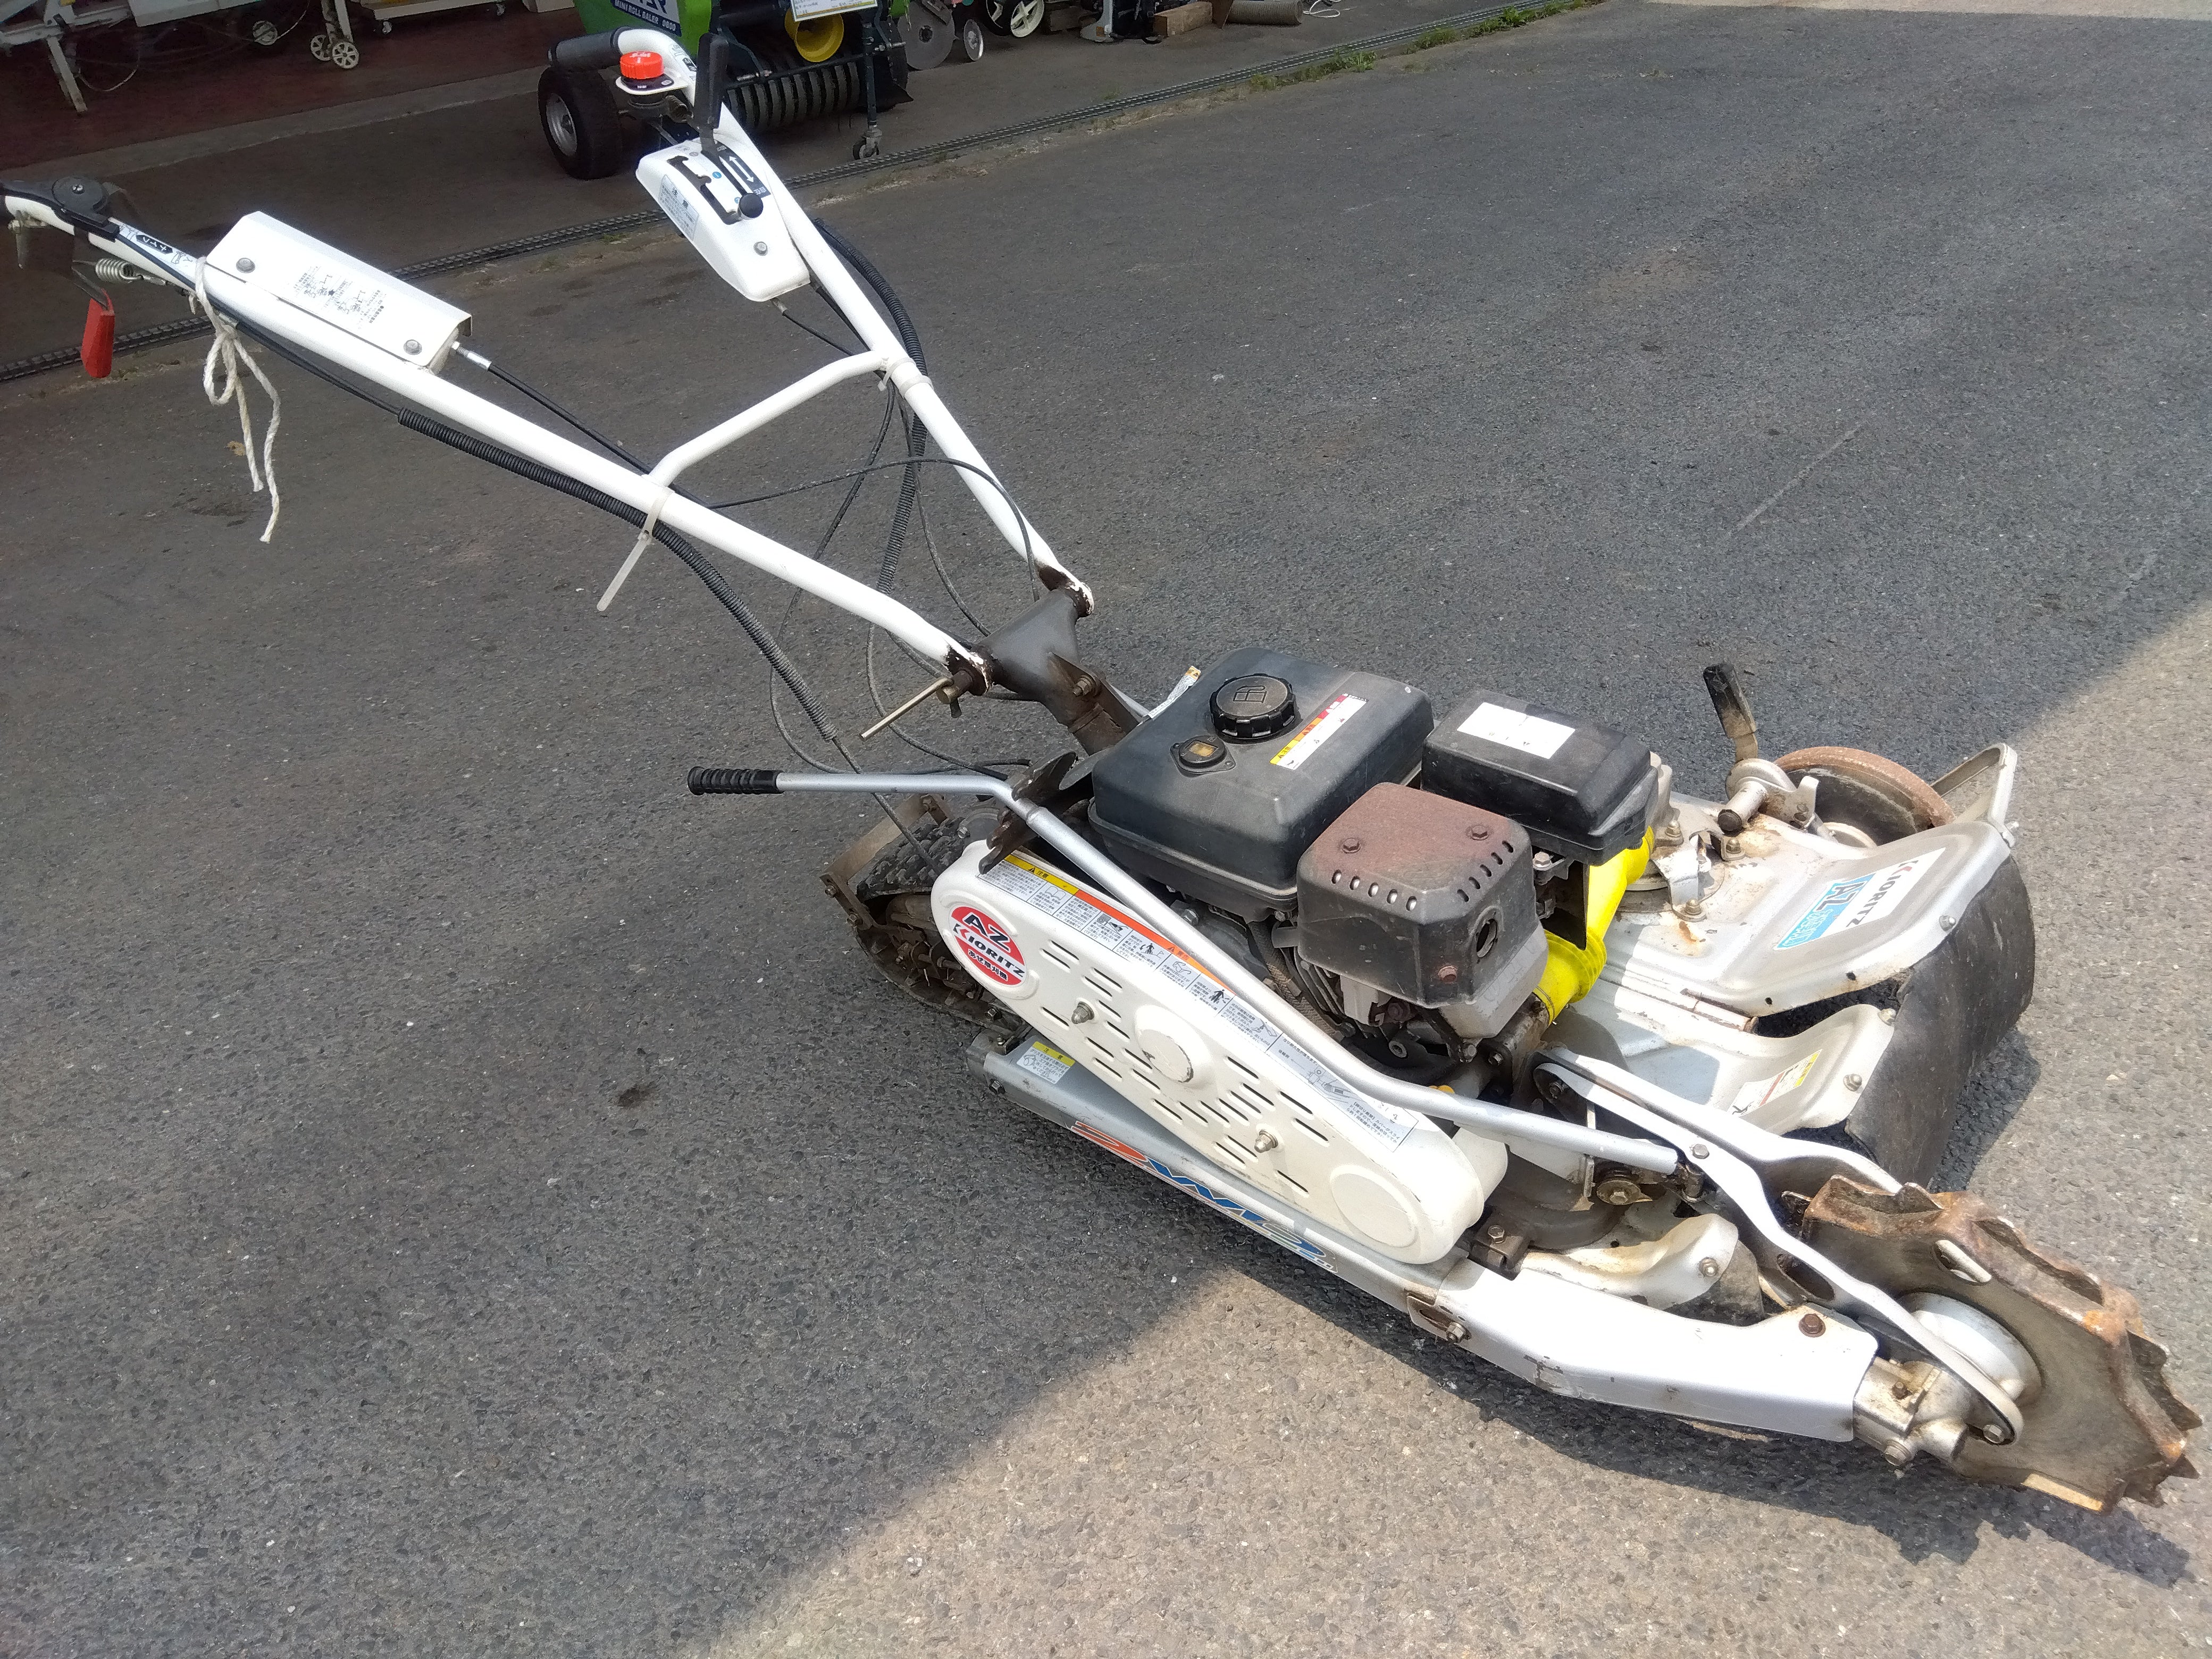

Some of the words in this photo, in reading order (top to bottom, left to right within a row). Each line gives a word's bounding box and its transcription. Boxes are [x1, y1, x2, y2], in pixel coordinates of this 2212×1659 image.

[1036, 868, 1049, 878] 注意
[1815, 882, 1865, 911] AZ
[1846, 860, 1919, 928] KIORITZ
[963, 914, 1010, 952] AZ
[953, 923, 1025, 978] KIORITZ
[968, 950, 1008, 981] あぜ草刈機
